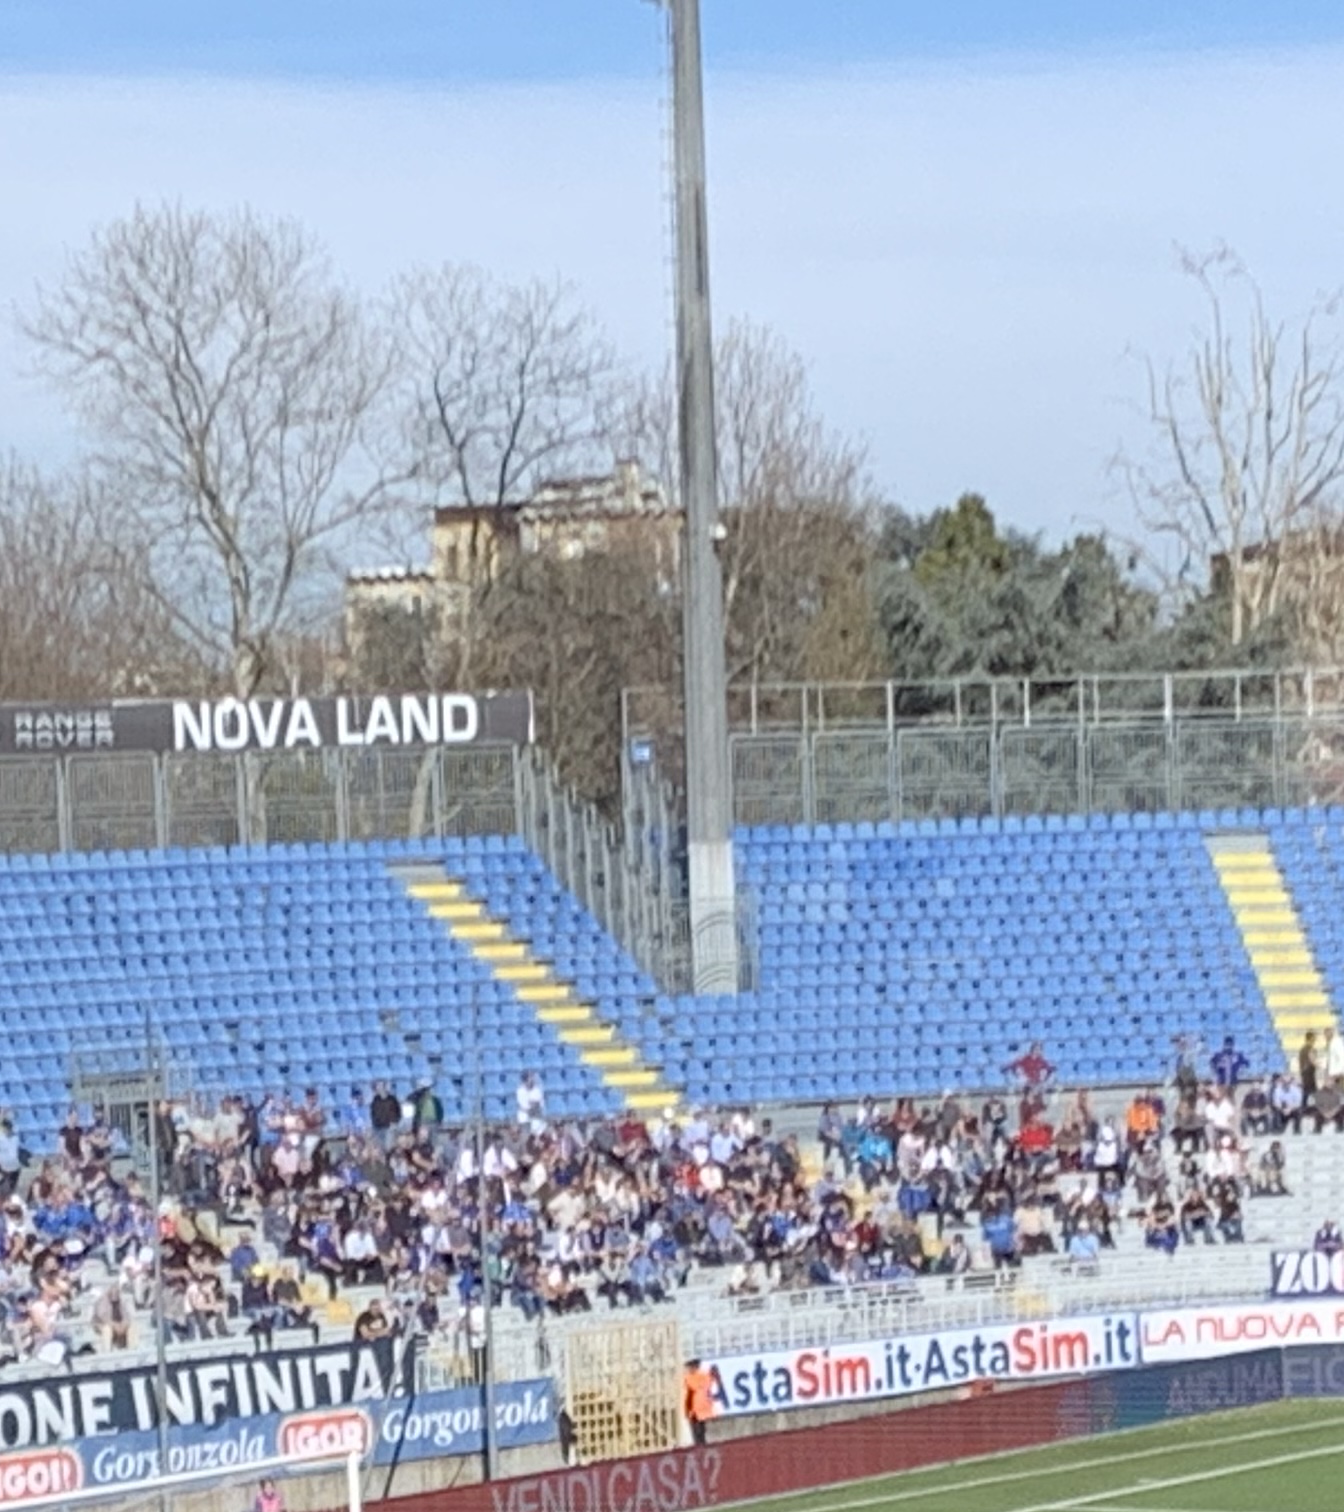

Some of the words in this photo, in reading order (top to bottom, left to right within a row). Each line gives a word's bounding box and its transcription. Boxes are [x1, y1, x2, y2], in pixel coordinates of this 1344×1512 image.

[173, 696, 321, 750] NOVA
[336, 694, 478, 745] LAND
[1144, 1319, 1186, 1347] LA
[130, 1337, 405, 1432] INFINITA!
[287, 1420, 364, 1457] IGOR
